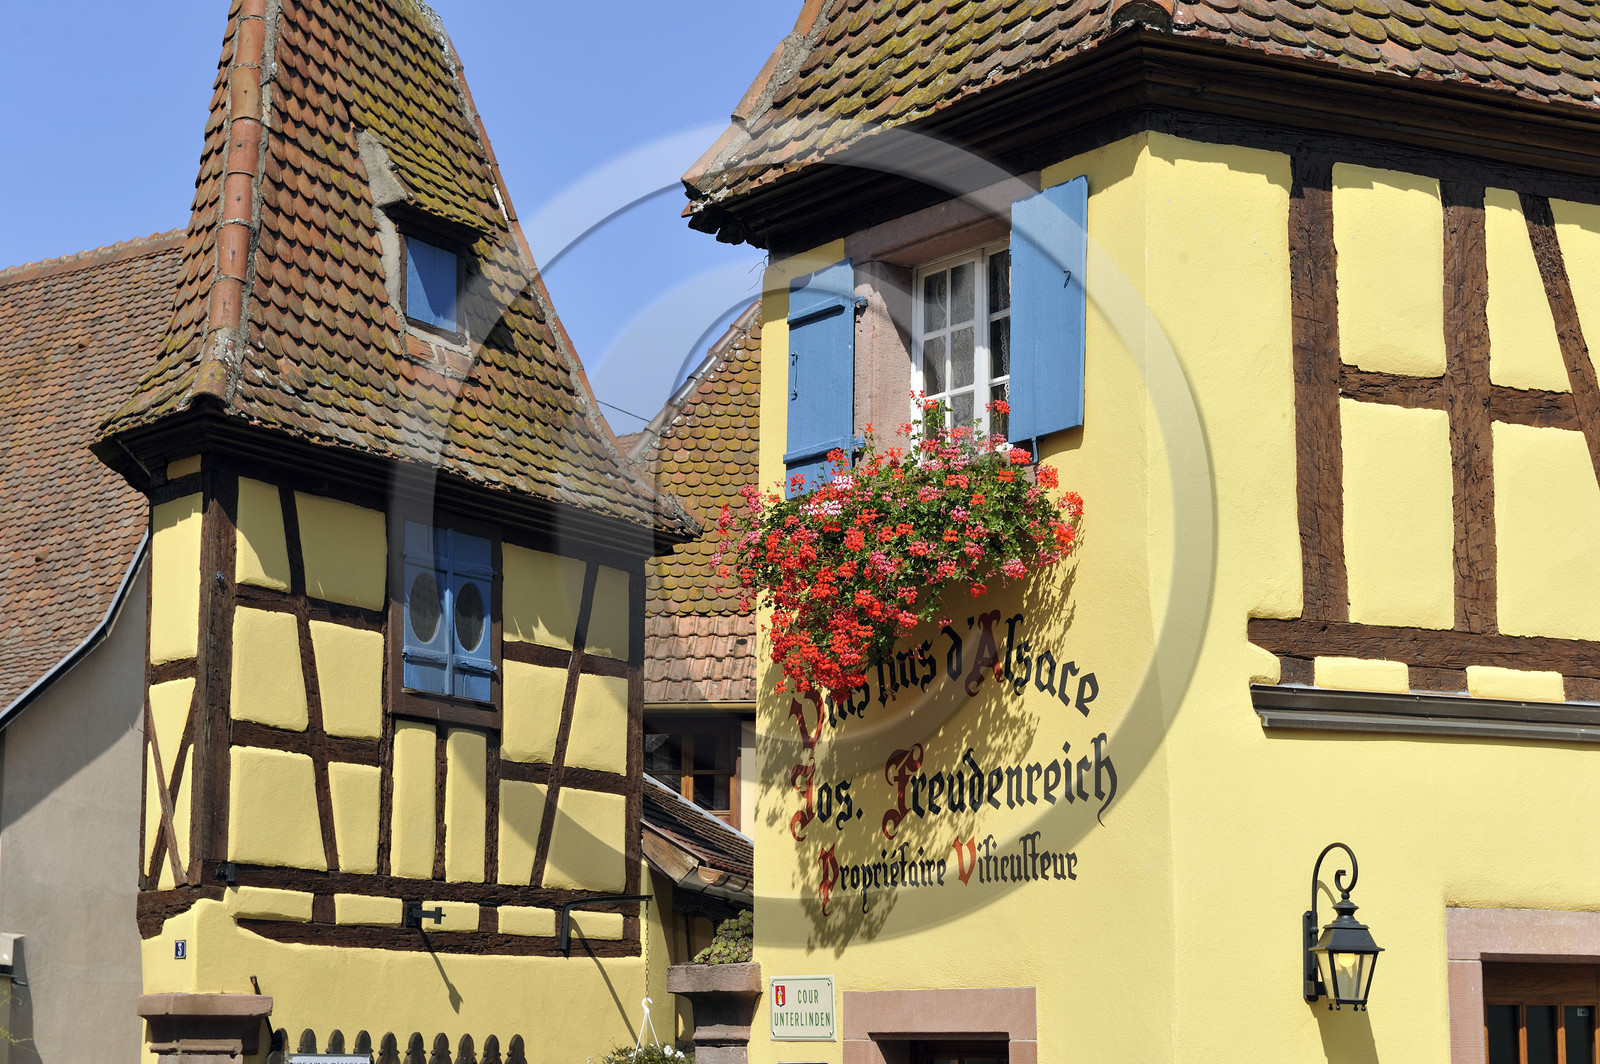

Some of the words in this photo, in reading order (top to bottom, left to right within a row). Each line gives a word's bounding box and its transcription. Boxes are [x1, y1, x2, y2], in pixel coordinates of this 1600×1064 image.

[941, 609, 1099, 717] d'Alsace
[790, 757, 863, 841] Jos.
[882, 732, 1117, 840] Freudenreich
[818, 843, 946, 917] Propriétaire
[952, 831, 1078, 887] Viticulteur
[774, 1012, 831, 1027] UNTERLINDEN
[797, 989, 819, 1004] COUR
